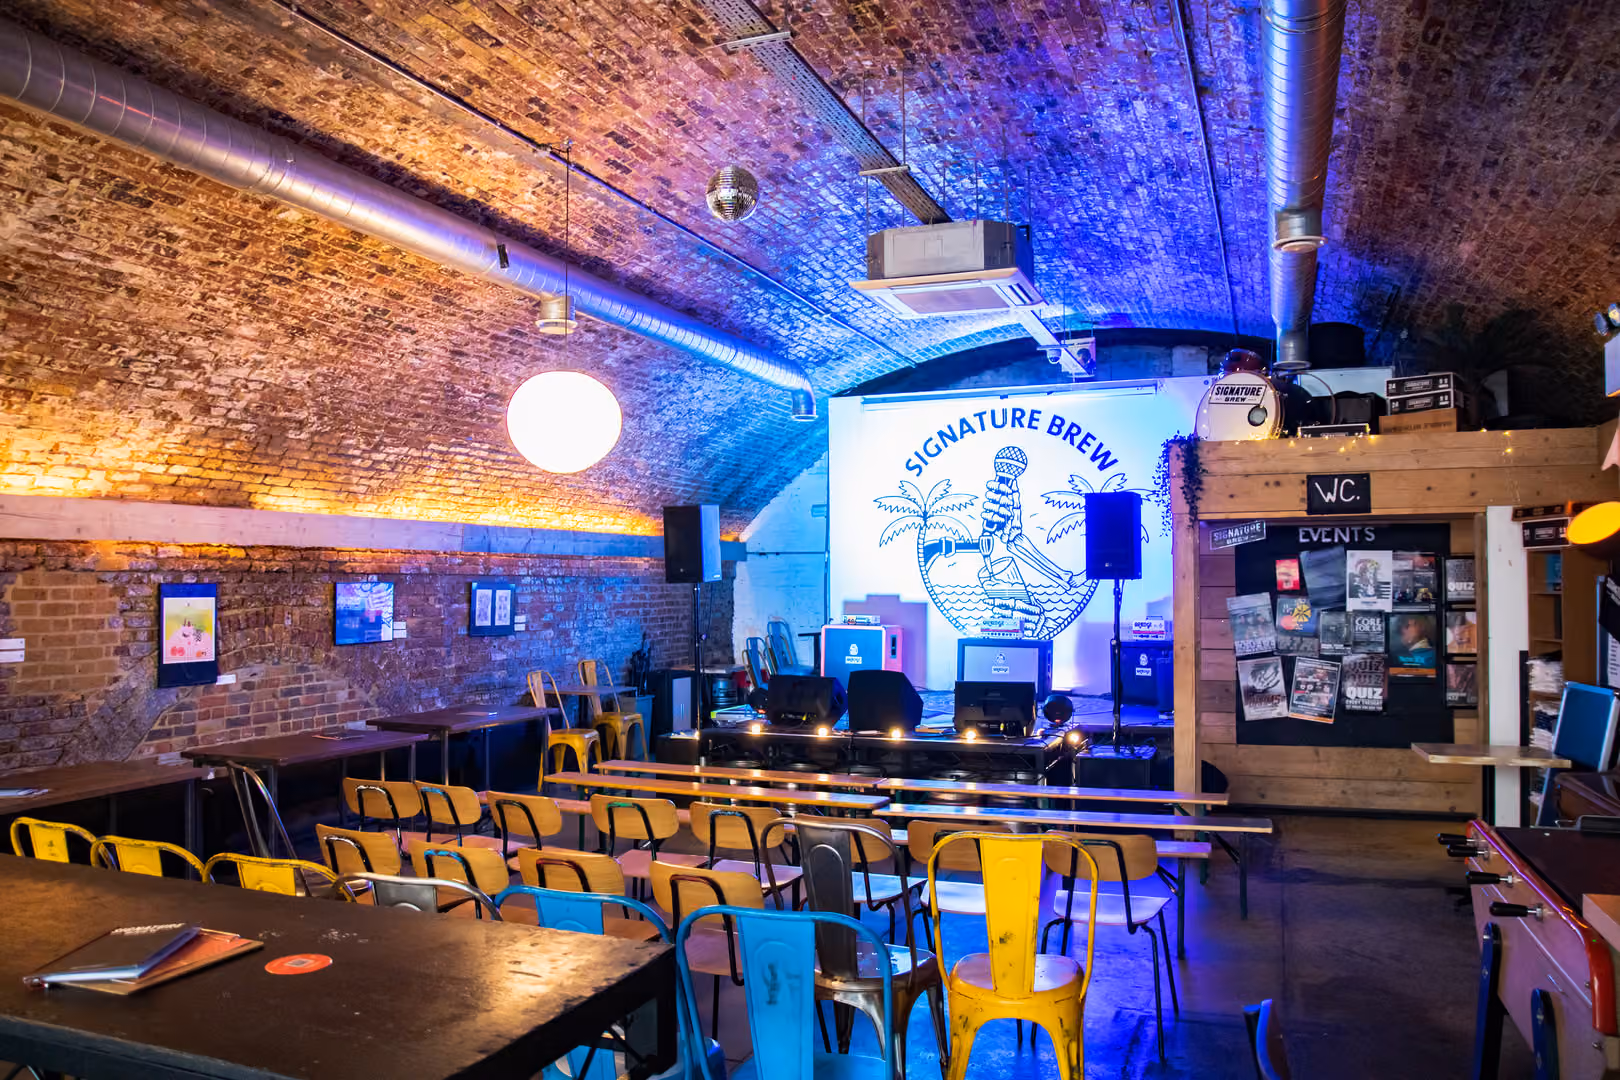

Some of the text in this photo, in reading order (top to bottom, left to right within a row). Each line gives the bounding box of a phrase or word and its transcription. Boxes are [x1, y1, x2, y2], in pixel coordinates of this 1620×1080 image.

[1214, 386, 1263, 397] SIGNATURE
[905, 407, 1119, 477] SIGNATURE BREW
[1213, 523, 1261, 542] SIGNATURE
[1299, 526, 1376, 543] EVENTS
[1447, 582, 1475, 592] QUIZ
[1346, 687, 1383, 700] QUIZ
